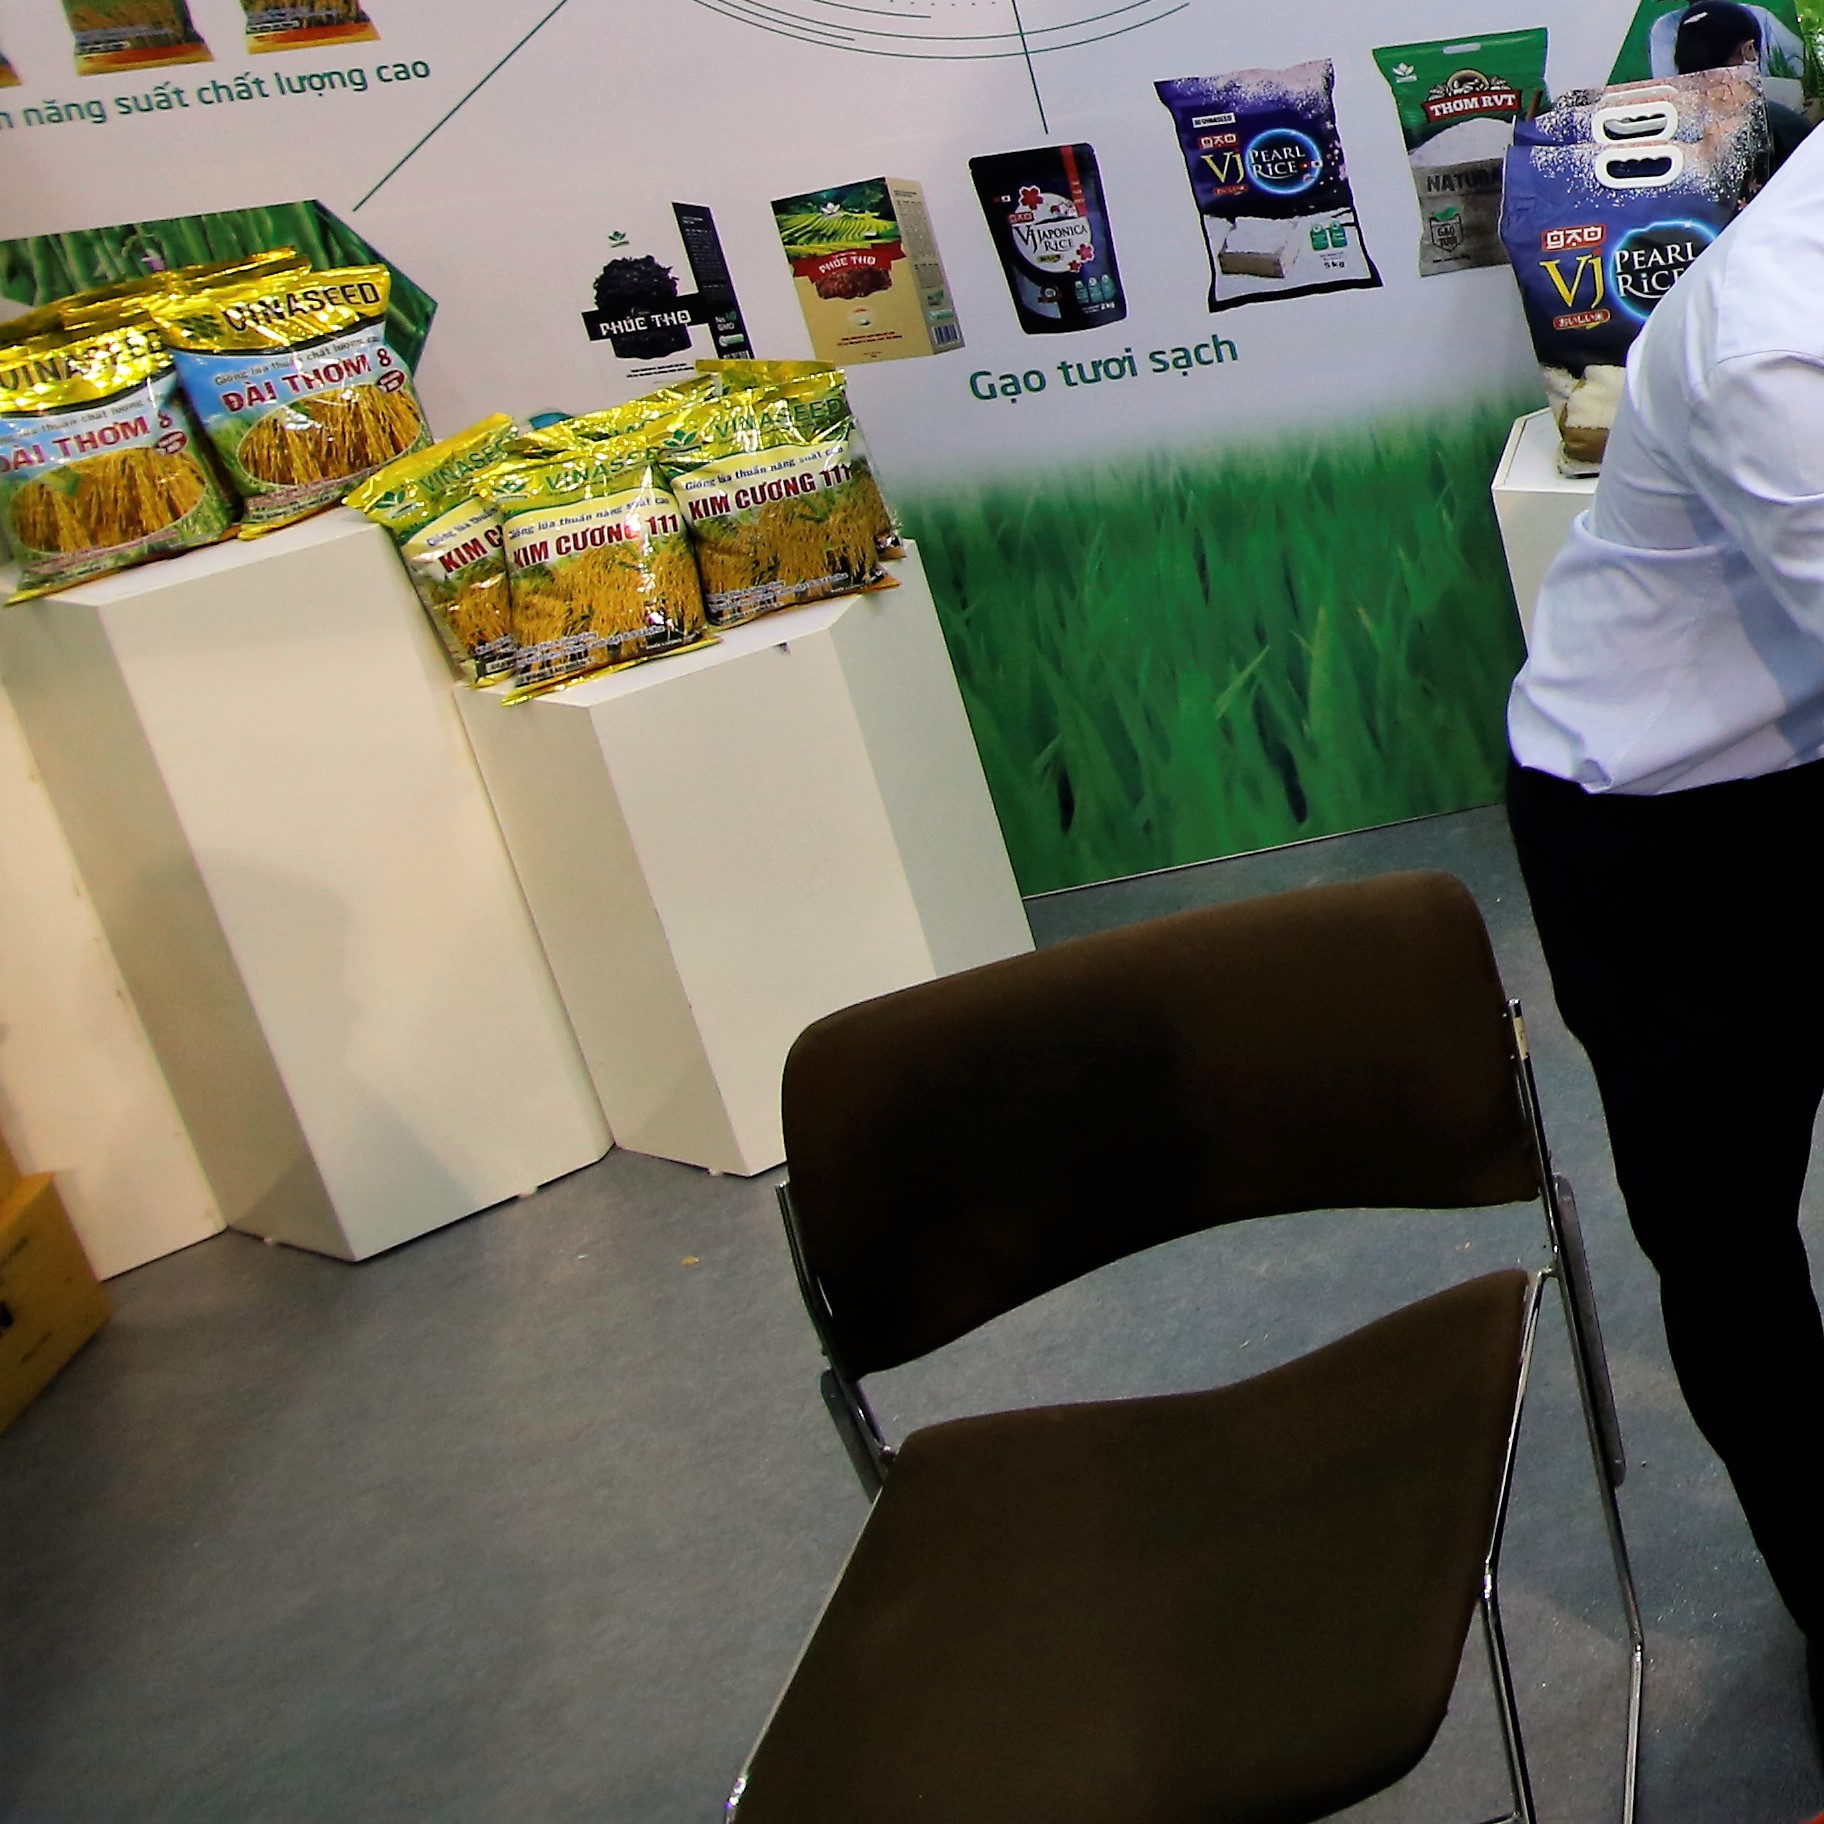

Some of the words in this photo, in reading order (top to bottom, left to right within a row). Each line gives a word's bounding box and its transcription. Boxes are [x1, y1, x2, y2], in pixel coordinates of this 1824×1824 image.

[23, 96, 107, 126] năng
[114, 81, 190, 115] suất
[195, 70, 270, 106] chất
[278, 70, 369, 97] lượng
[376, 59, 432, 85] cao
[1481, 93, 1517, 109] RVT
[1250, 145, 1307, 164] PEARL
[1615, 242, 1701, 273] PEARL
[221, 379, 277, 413] ĐÀI
[281, 353, 373, 395] THƠM
[377, 347, 392, 368] 8
[968, 368, 1047, 405] Gạo
[1057, 346, 1139, 389] tươi
[1148, 333, 1240, 377] sạch
[51, 415, 151, 458] THƠM
[687, 493, 732, 522] KIM
[735, 470, 817, 510] CƯƠNG
[438, 536, 488, 574] KIM
[513, 539, 550, 570] KIM
[554, 518, 641, 557] CƯƠNG
[646, 513, 679, 536] 111
